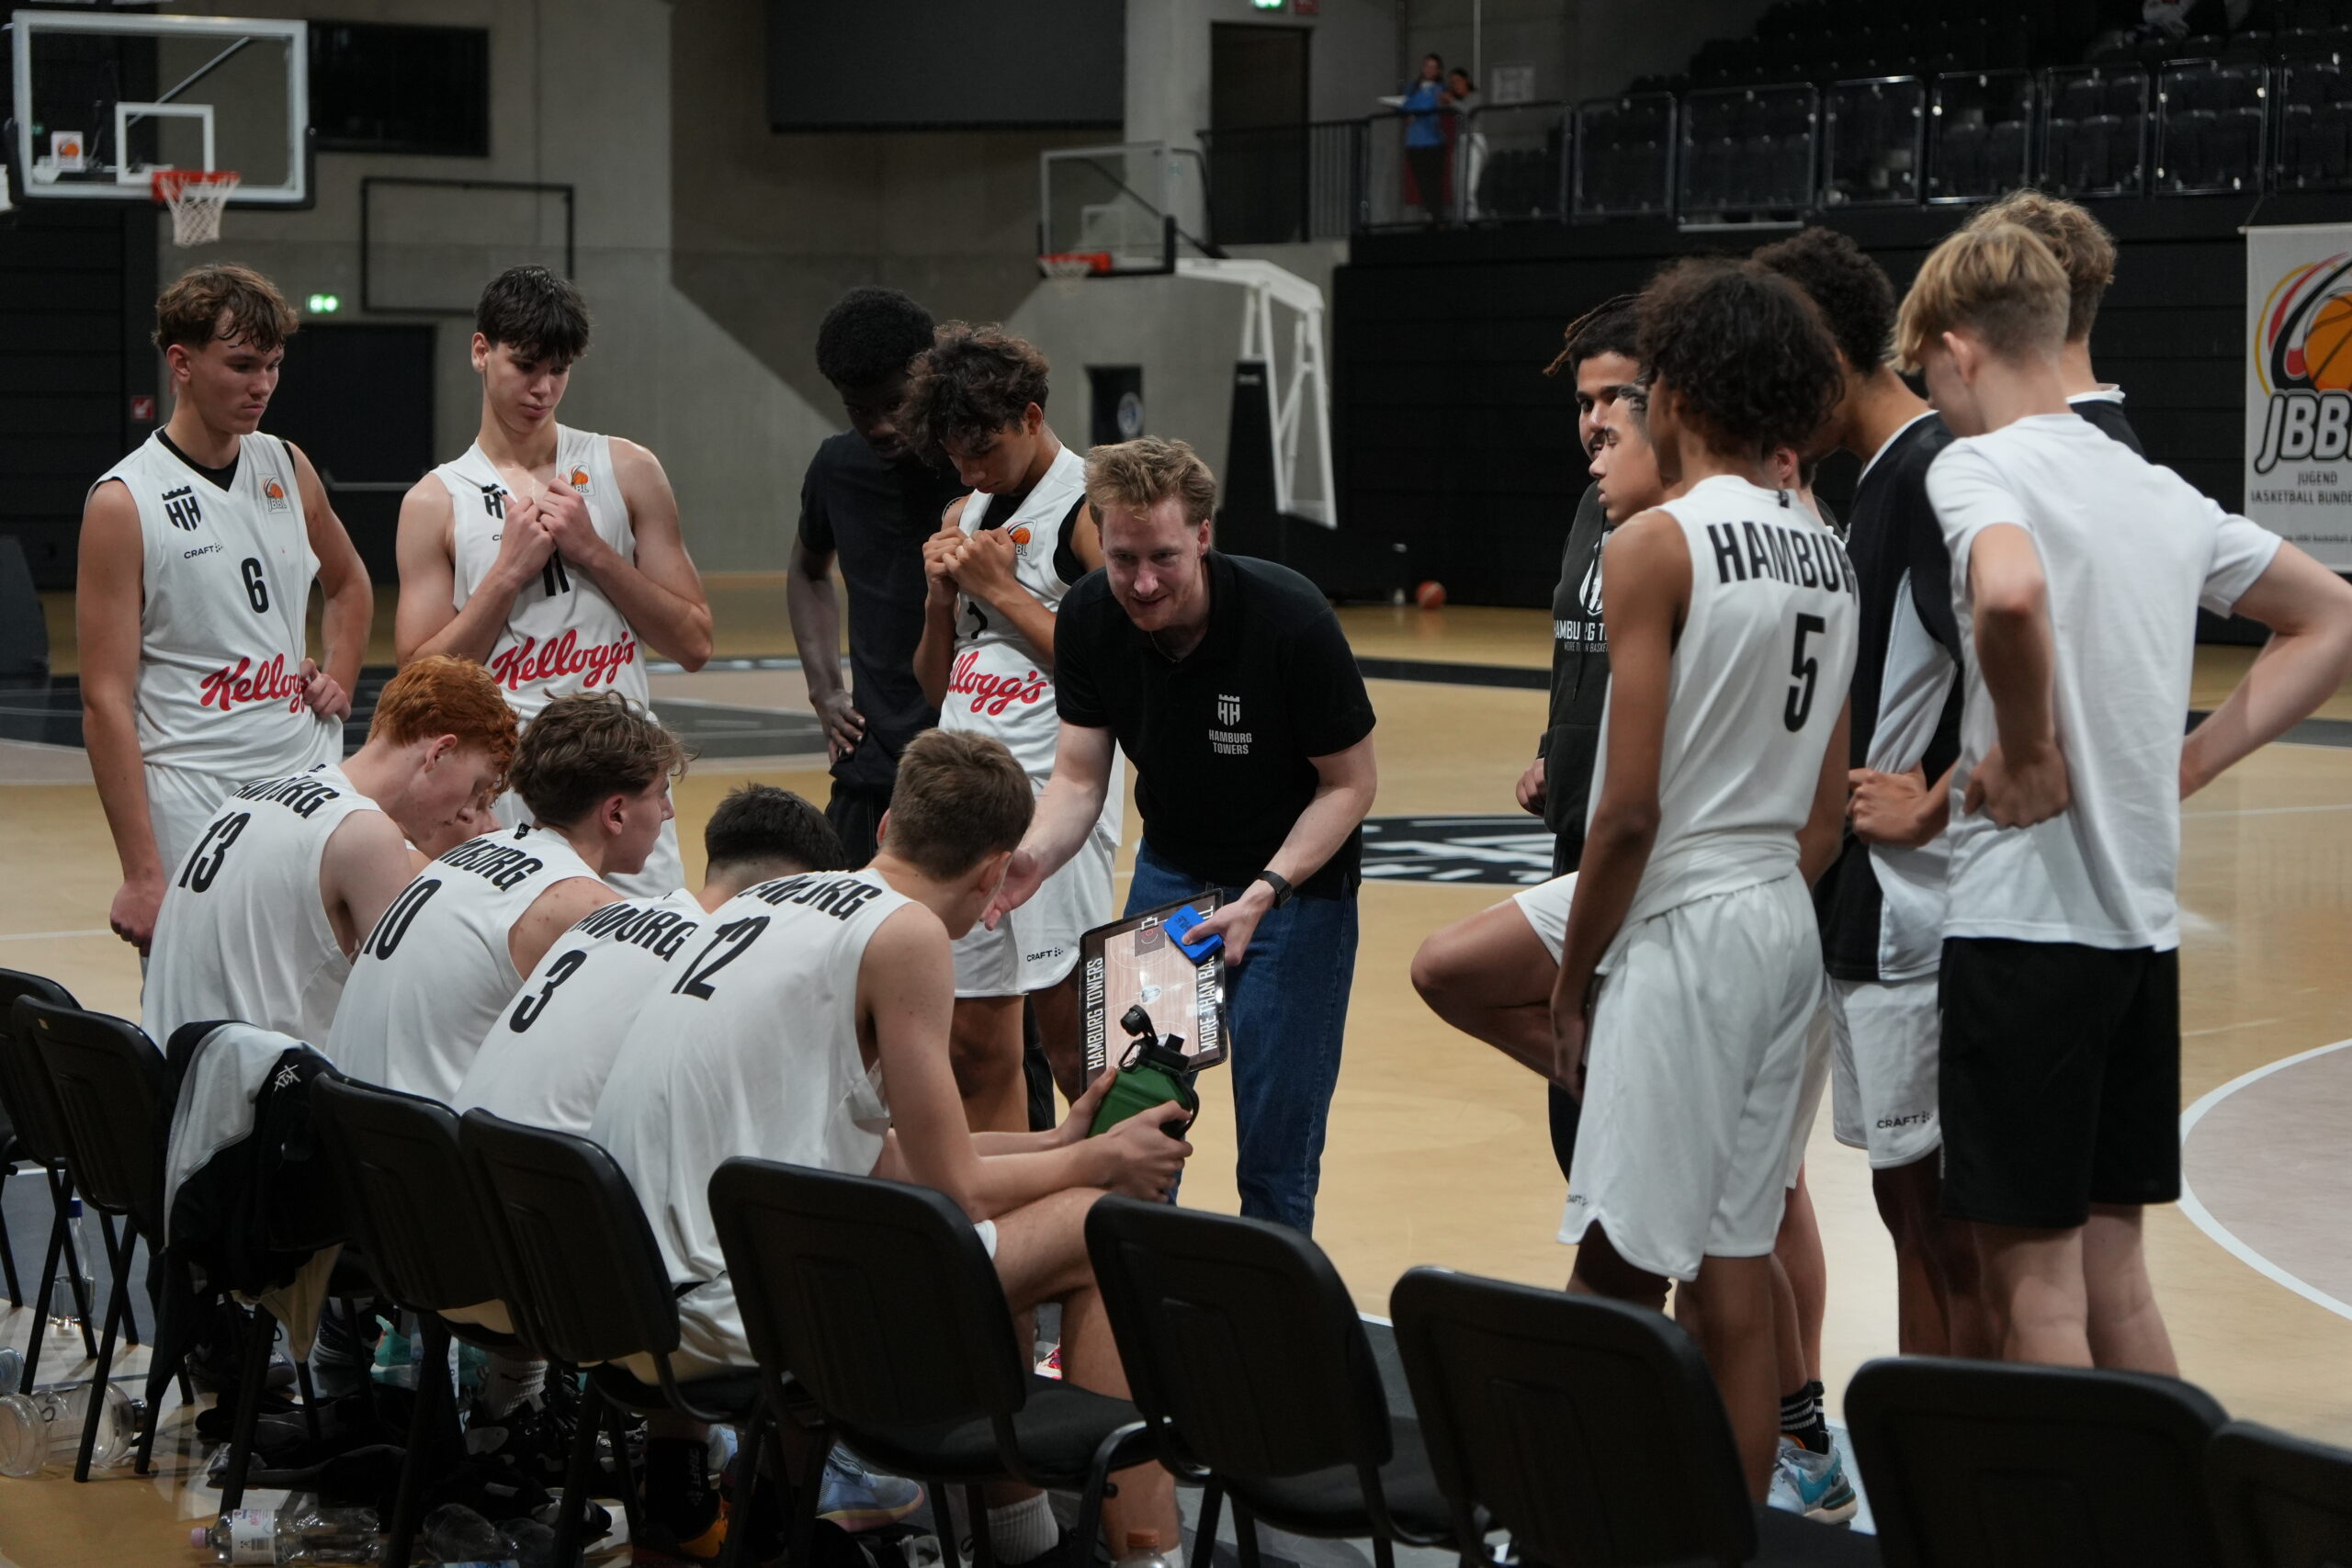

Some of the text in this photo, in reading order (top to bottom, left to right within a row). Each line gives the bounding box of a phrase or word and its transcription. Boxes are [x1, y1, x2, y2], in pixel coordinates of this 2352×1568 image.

[2255, 392, 2352, 475] JBB
[2298, 471, 2338, 486] JUGEND
[2318, 490, 2352, 504] BUNDE
[266, 499, 287, 512] JBBL
[184, 545, 215, 558] CRAFT
[1707, 521, 1856, 601] HAMBU
[241, 558, 269, 614] 6
[1554, 620, 1596, 641] AMBUG
[200, 653, 309, 713] Kellog
[492, 629, 636, 691] Kellogg's
[1784, 613, 1826, 732] 5
[1208, 729, 1252, 743] HAMBURG
[1213, 742, 1250, 755] TOWERS
[177, 811, 251, 893] 13
[363, 875, 442, 961] 10
[671, 916, 771, 1001] 12
[1026, 950, 1053, 962] CRAFT
[509, 950, 588, 1033] 3
[1086, 957, 1103, 1071] HAMBURG TOWERS
[1199, 984, 1216, 1020] THAN
[1201, 1020, 1218, 1053] MORE
[1877, 1114, 1920, 1129] CRAFT
